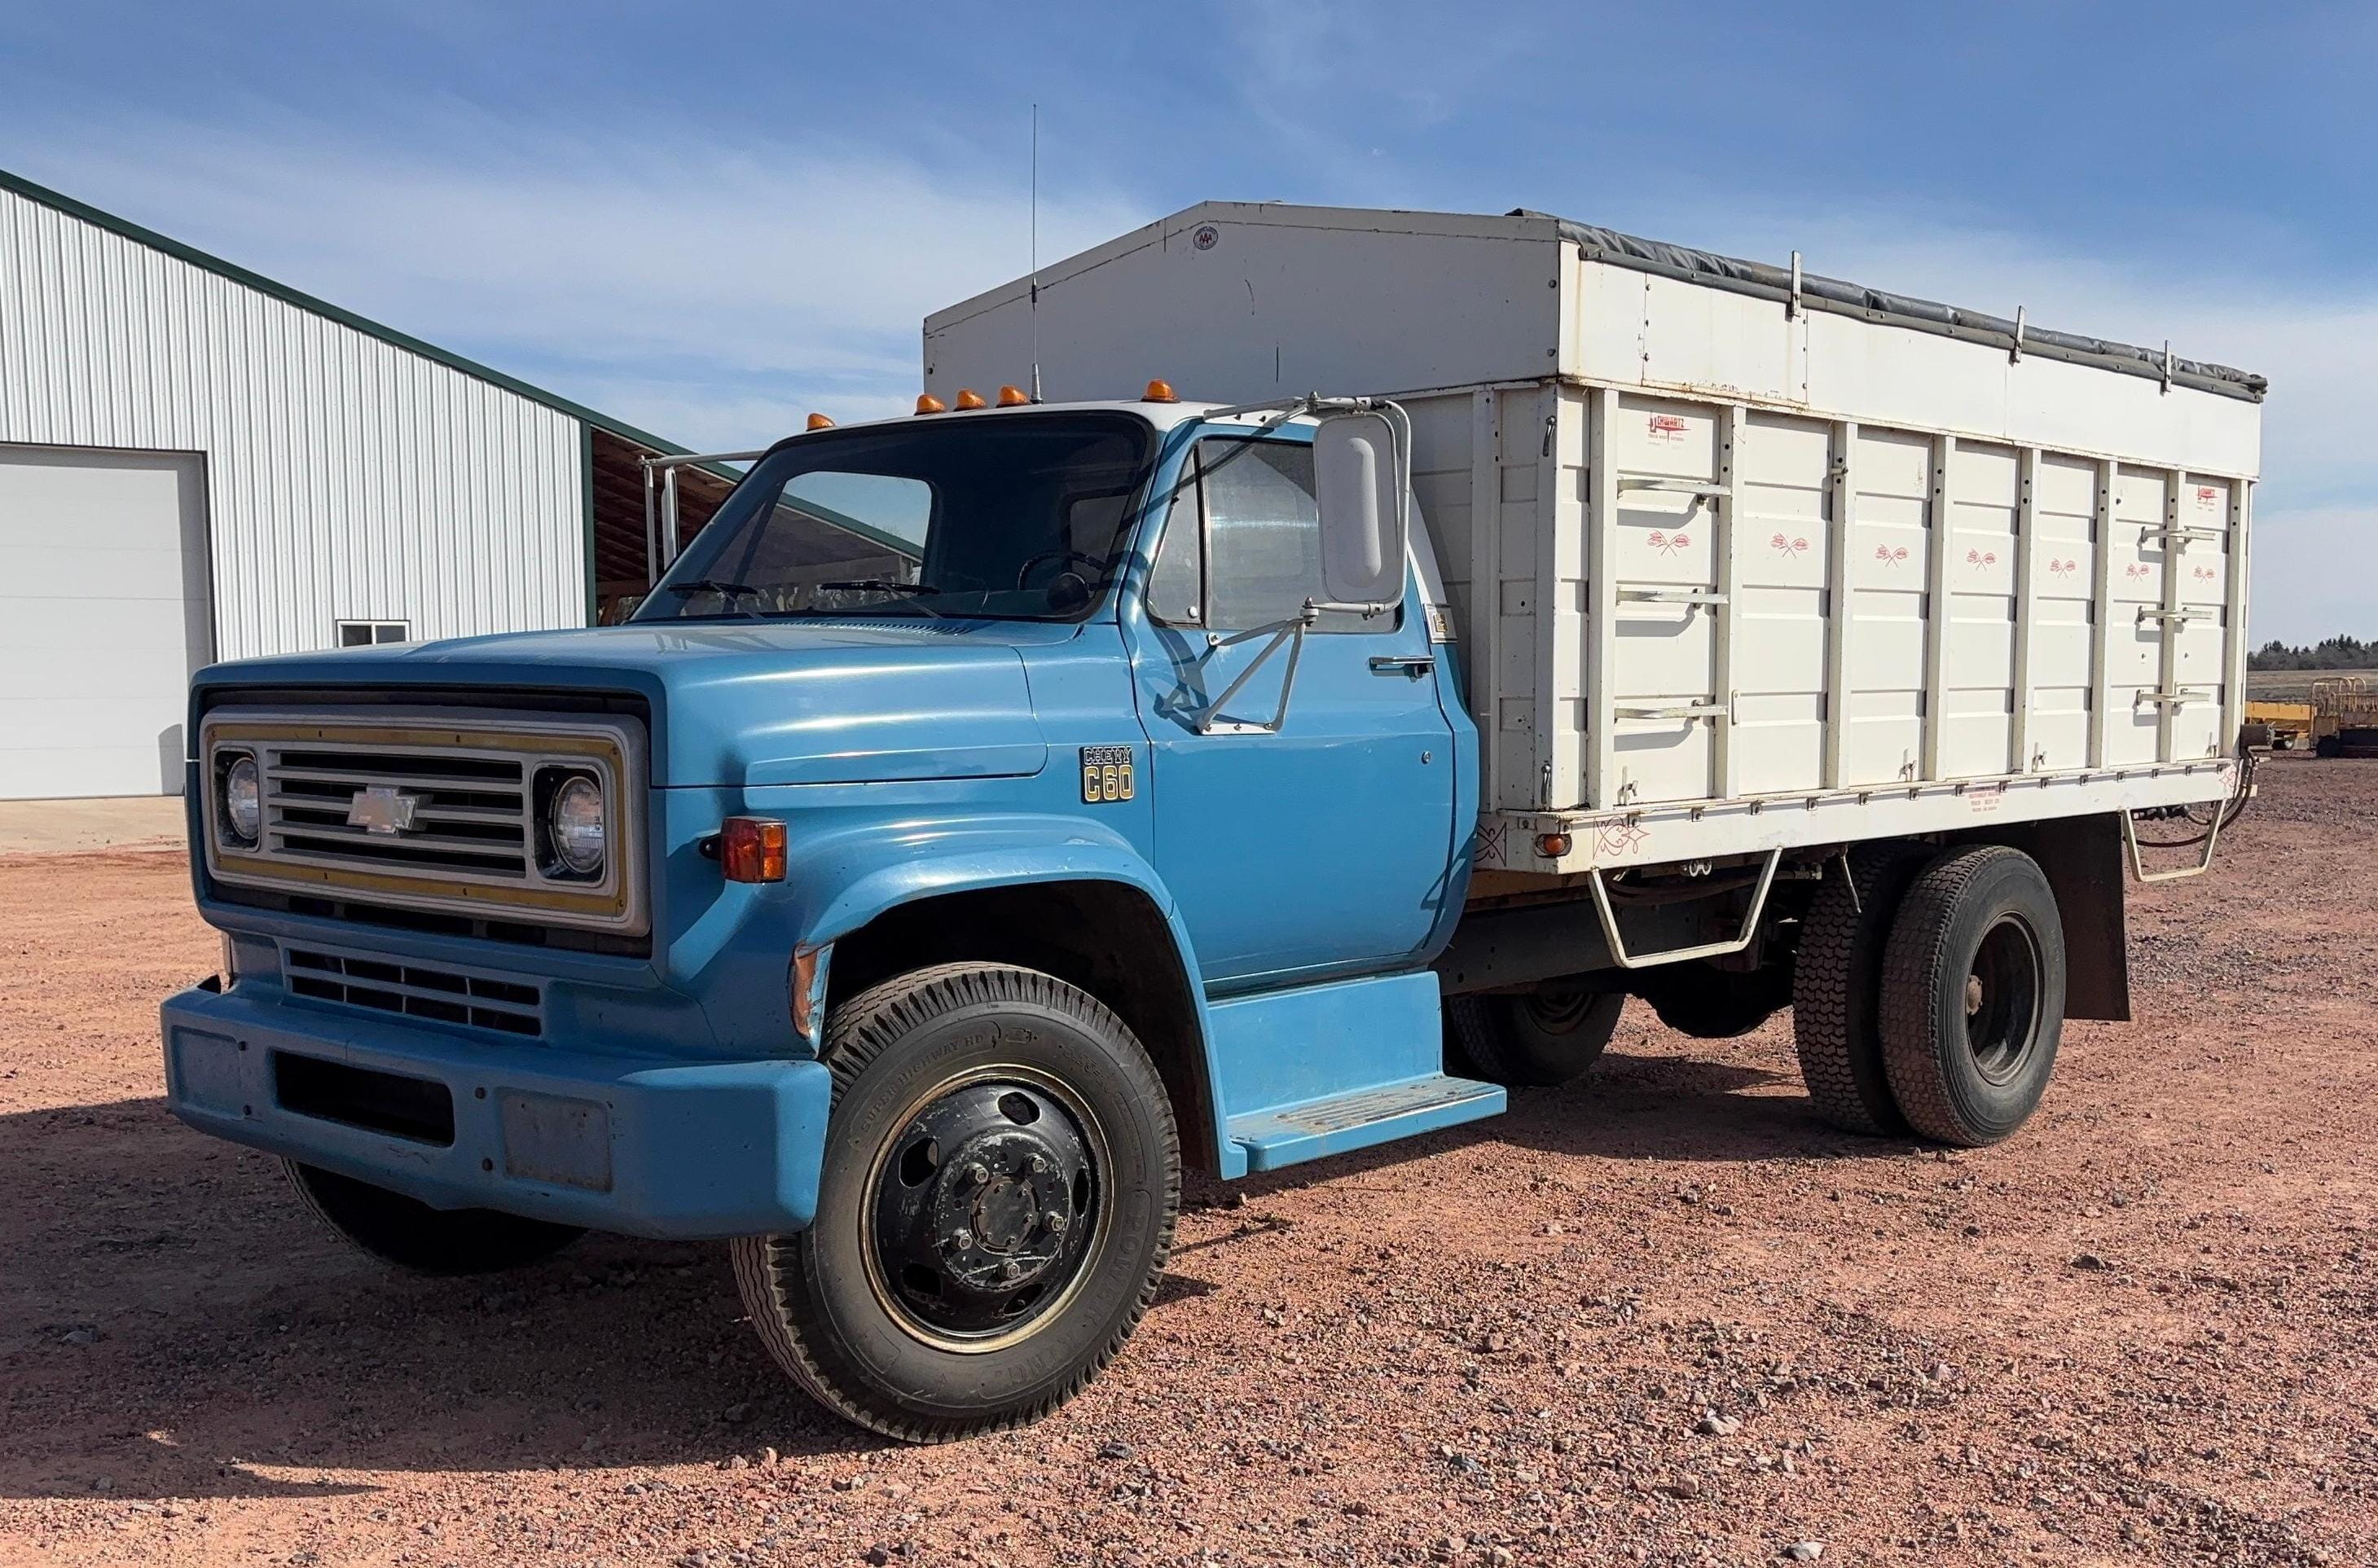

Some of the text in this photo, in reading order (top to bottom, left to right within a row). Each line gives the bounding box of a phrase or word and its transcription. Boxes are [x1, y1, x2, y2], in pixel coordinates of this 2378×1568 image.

[1084, 745, 1132, 765] CHEVY
[1084, 765, 1134, 802] C60
[965, 1034, 984, 1048] HD
